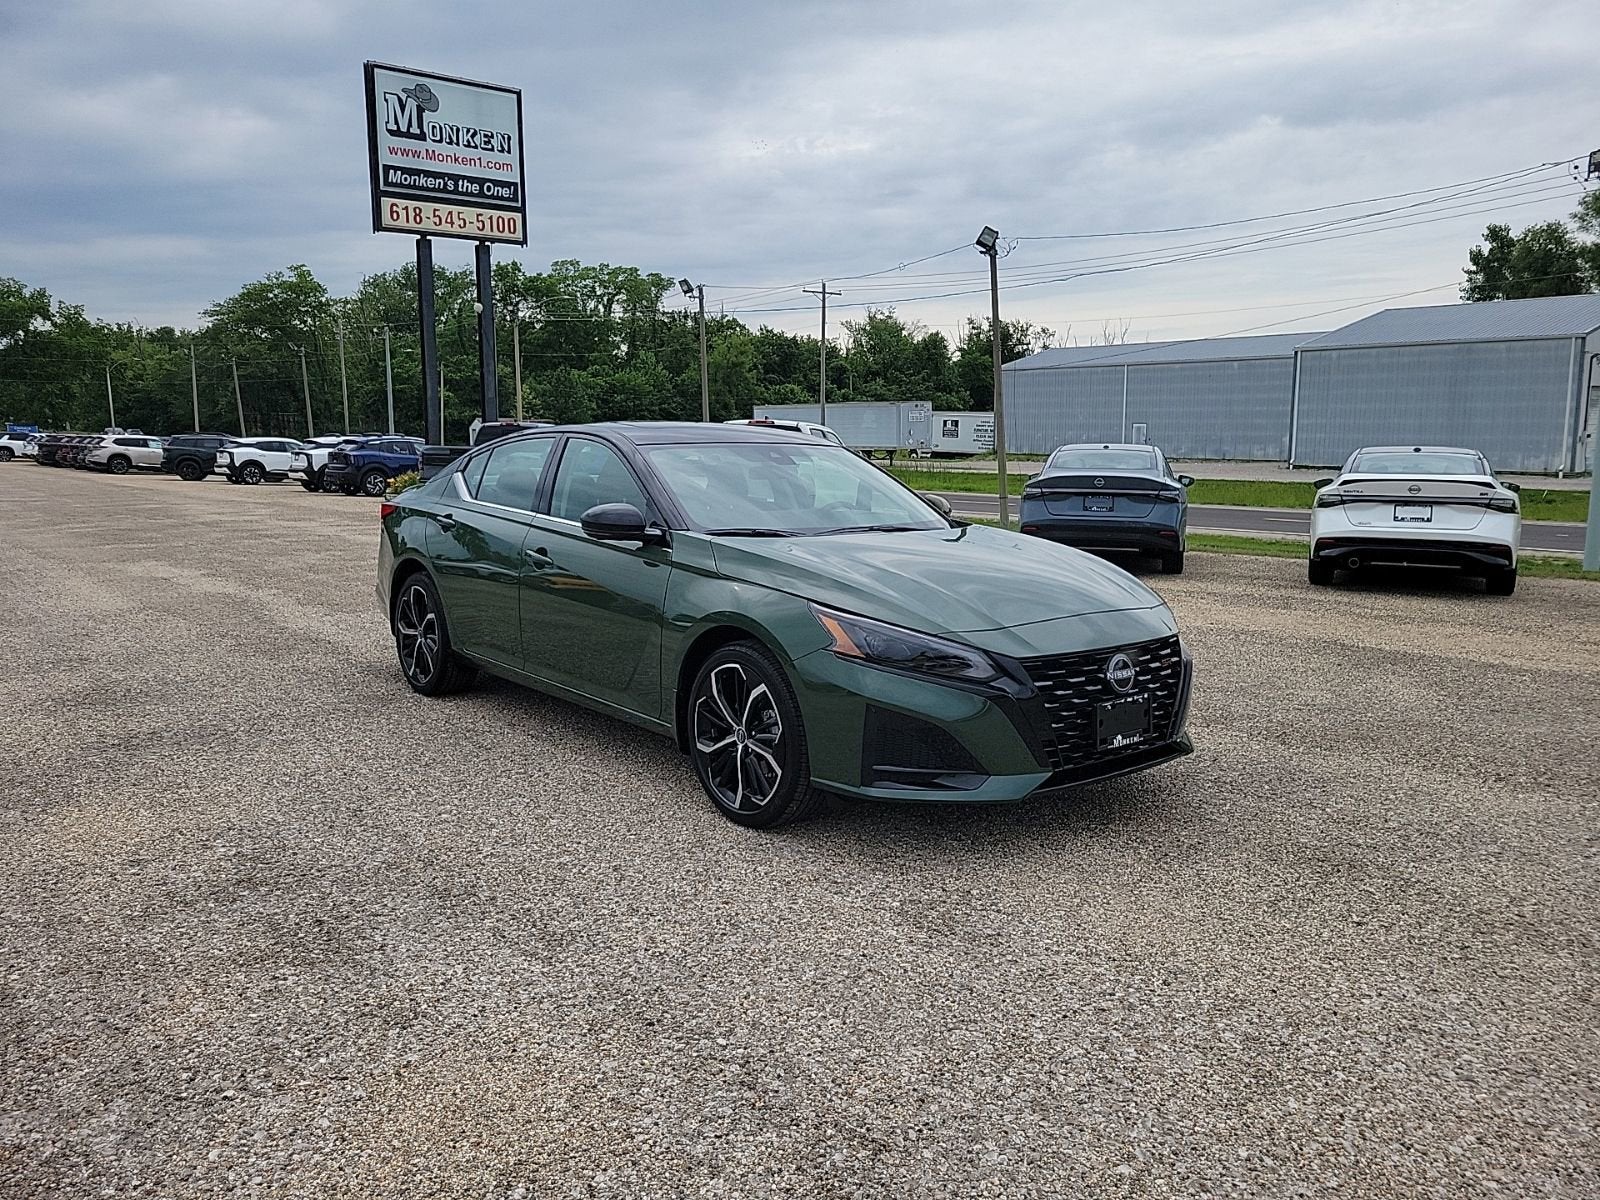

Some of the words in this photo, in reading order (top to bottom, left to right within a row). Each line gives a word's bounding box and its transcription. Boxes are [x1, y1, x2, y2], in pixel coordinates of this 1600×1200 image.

[388, 145, 513, 172] www.Monken1.com
[388, 169, 454, 191] Monken's
[458, 179, 480, 193] the
[483, 182, 514, 198] One!
[389, 202, 517, 235] 618-545-5100
[1106, 667, 1136, 680] NISSAN
